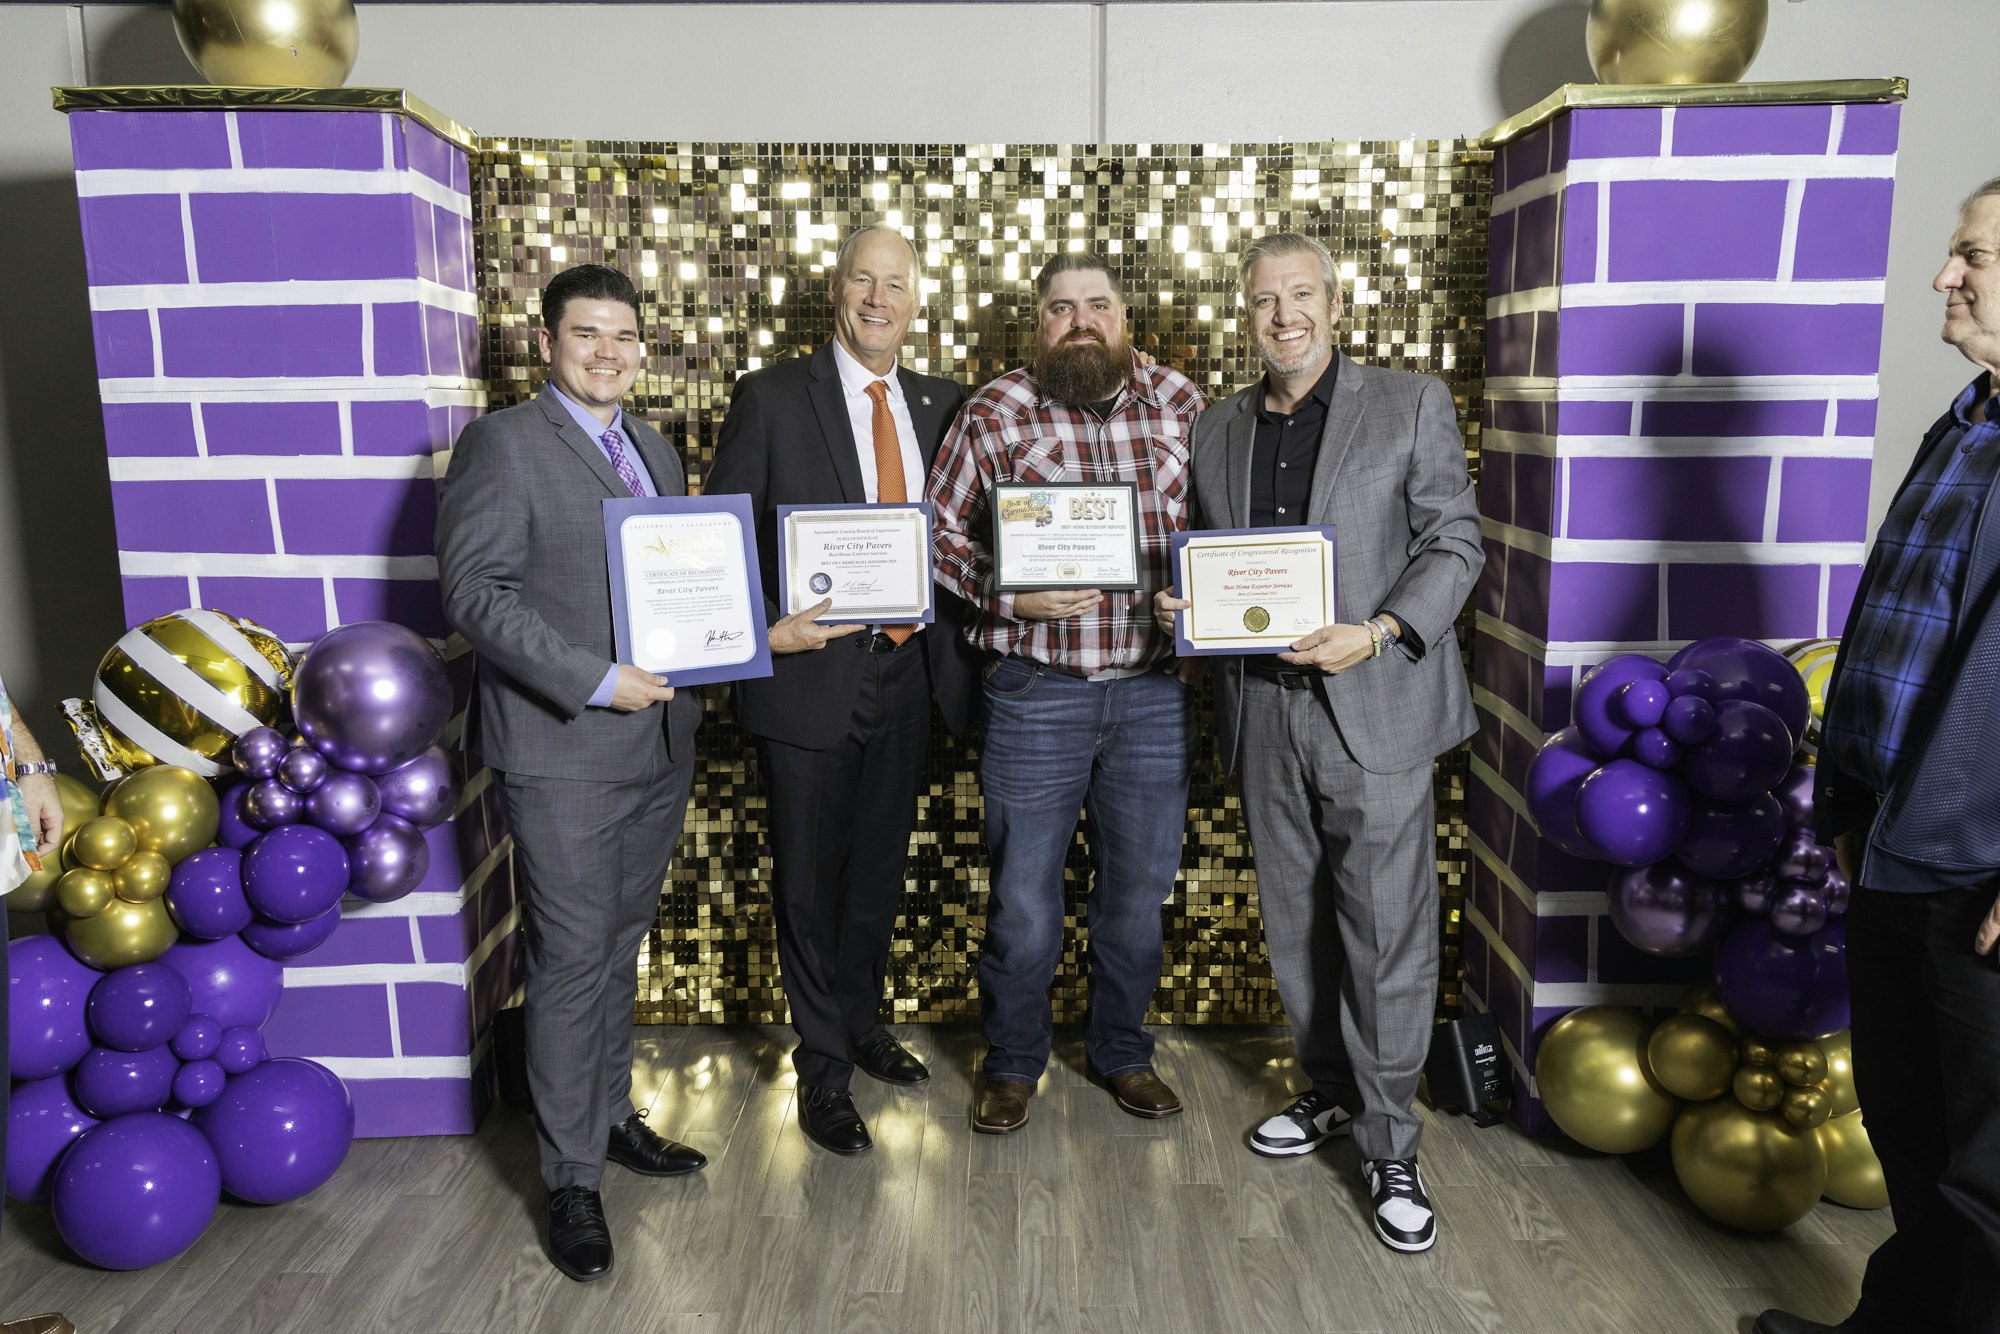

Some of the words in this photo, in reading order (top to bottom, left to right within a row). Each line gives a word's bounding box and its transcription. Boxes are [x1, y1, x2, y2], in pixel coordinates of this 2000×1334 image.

[1069, 498, 1117, 520] BEST
[847, 542, 864, 551] City
[1197, 550, 1228, 559] Certificate
[1237, 548, 1279, 557] Congressional
[1281, 547, 1317, 555] Recognition
[1248, 568, 1263, 576] City
[678, 586, 693, 594] City
